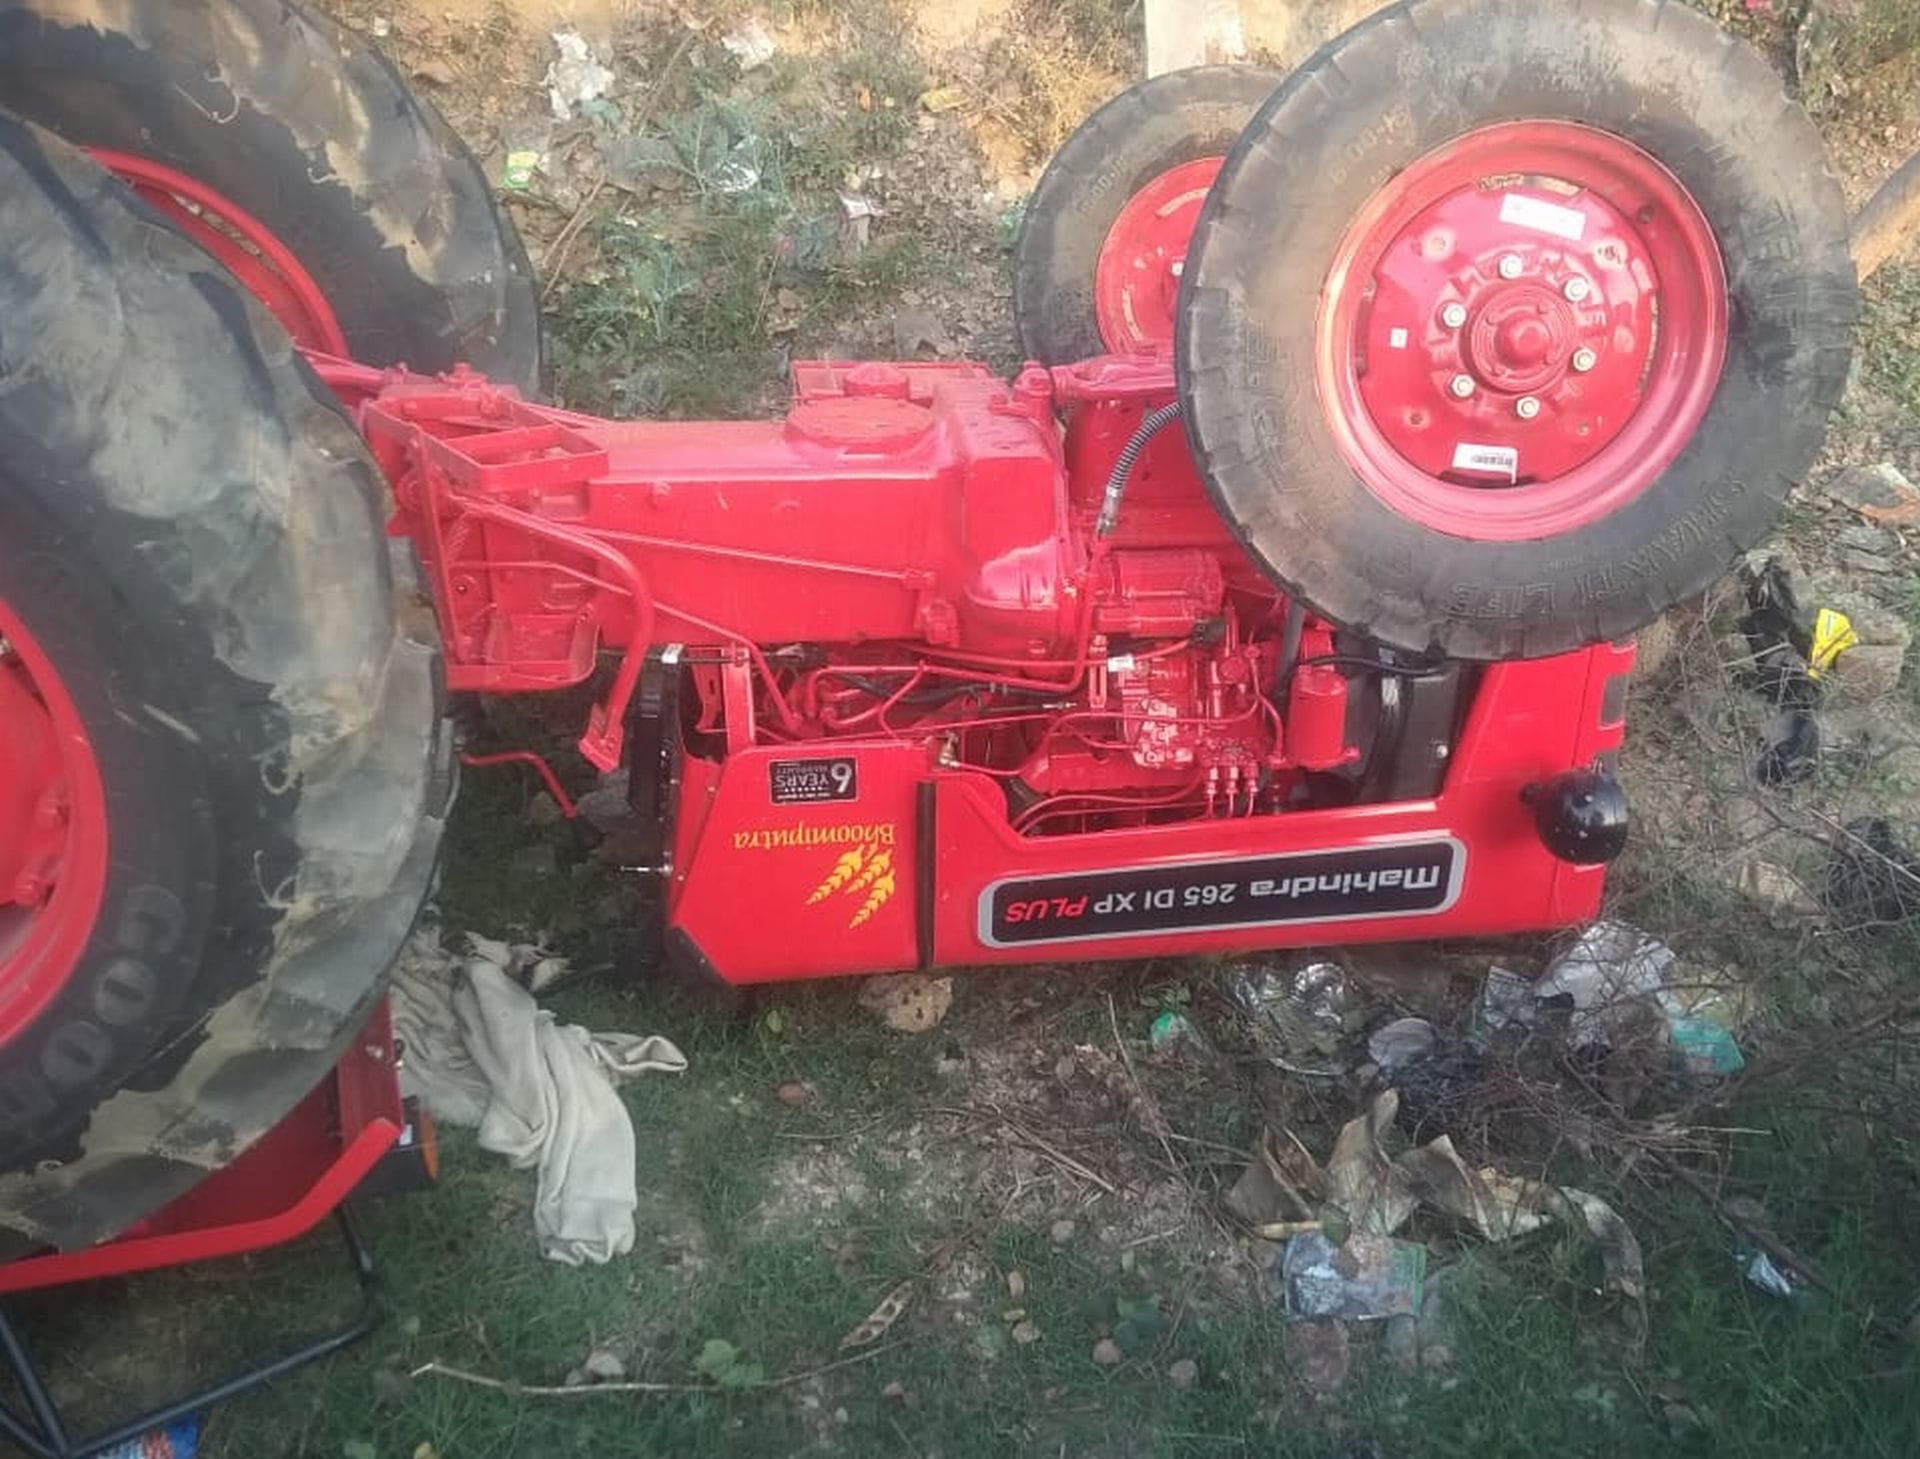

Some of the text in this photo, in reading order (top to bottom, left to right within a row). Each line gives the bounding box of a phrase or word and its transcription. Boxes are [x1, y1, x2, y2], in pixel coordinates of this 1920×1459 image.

[1447, 581, 1556, 618] LIFE
[776, 773, 828, 787] YEARS
[831, 763, 852, 793] 6
[734, 821, 894, 854] Bhoomiputra
[1005, 864, 1439, 922] Mahindra 265 DI XP PLUS
